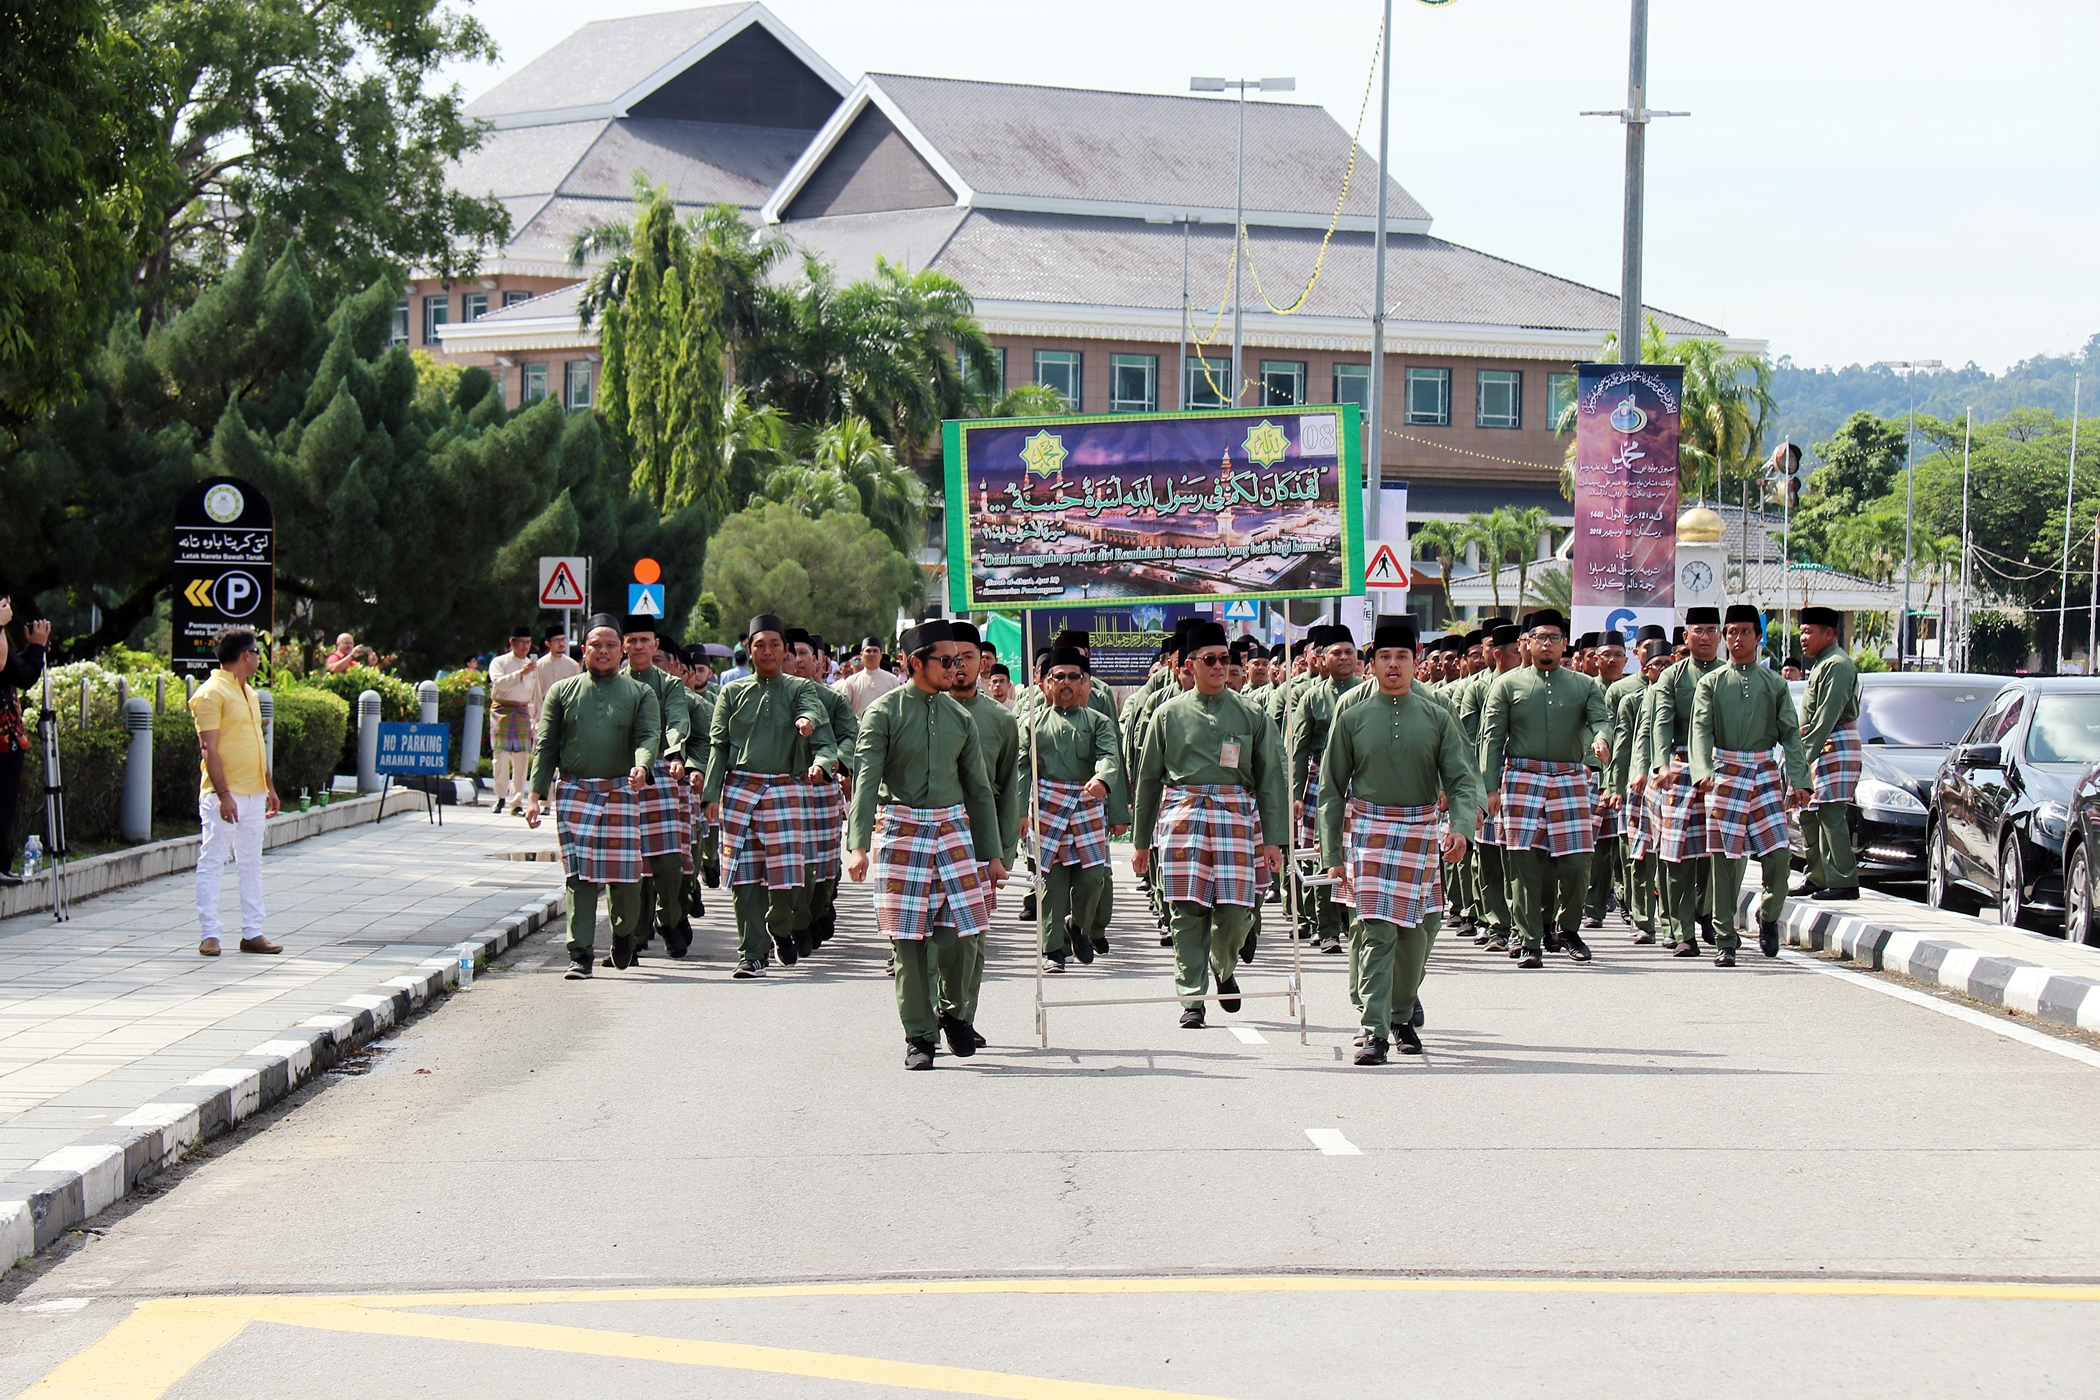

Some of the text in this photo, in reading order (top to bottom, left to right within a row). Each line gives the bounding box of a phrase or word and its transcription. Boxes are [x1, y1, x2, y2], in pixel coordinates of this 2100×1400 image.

[1302, 424, 1335, 449] 08
[182, 552, 200, 560] Letak
[1010, 551, 1071, 567] sesungguhnya
[1071, 549, 1095, 566] pada
[1096, 549, 1114, 561] diri
[1115, 546, 1163, 560] Rasulullah
[1164, 545, 1178, 559] itu
[1178, 544, 1196, 558] ada
[1196, 542, 1227, 558] contoh
[1227, 545, 1251, 560] yang
[1250, 541, 1271, 555] baik
[1271, 541, 1292, 558] bagi
[227, 577, 251, 610] P
[188, 621, 222, 630] Pemegang
[186, 662, 209, 670] BUKA
[383, 734, 442, 753] NO PARKING
[380, 754, 445, 768] ARAHAN POLIS
